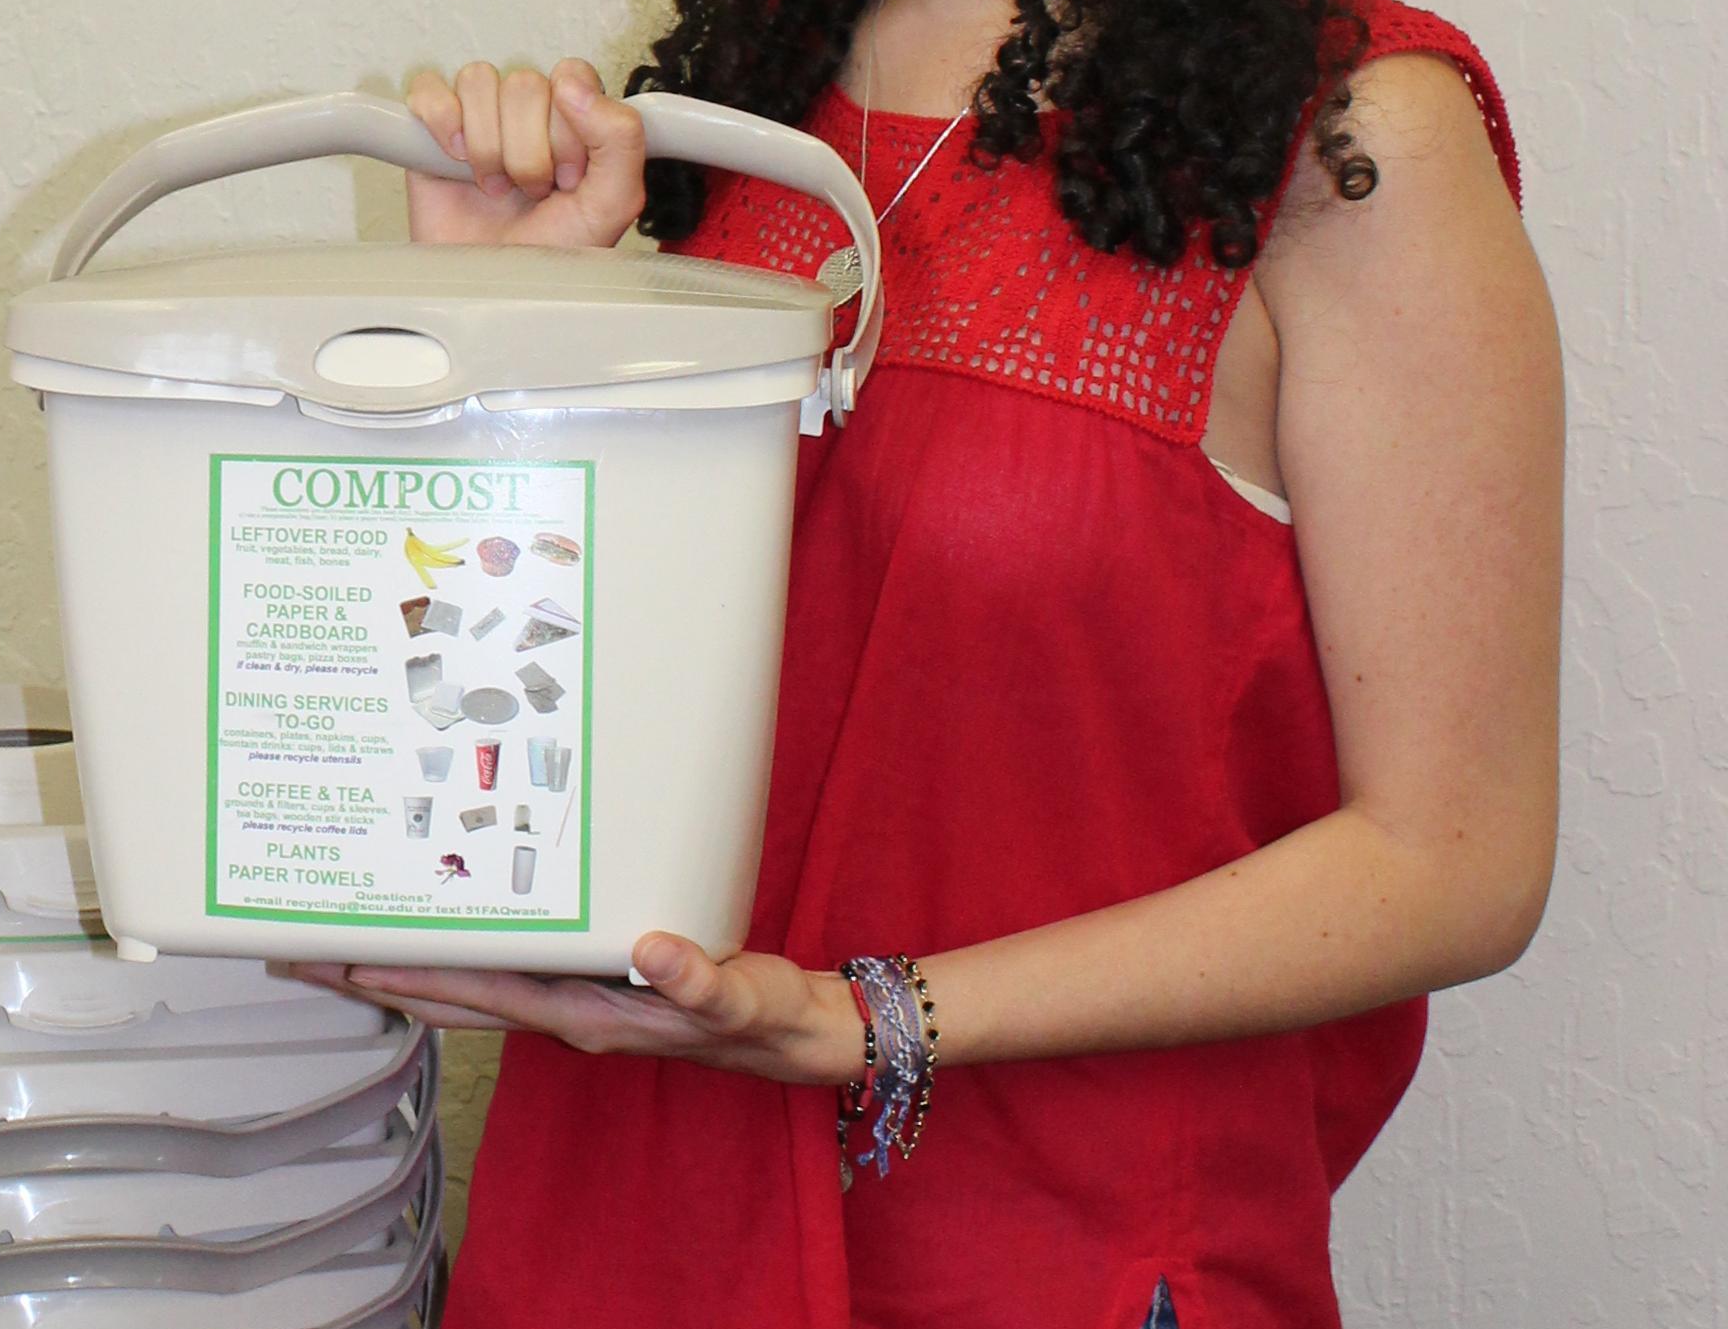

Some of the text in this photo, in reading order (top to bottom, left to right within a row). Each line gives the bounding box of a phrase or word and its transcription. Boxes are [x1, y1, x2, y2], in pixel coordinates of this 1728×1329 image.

[272, 468, 530, 511] COMPOST
[231, 526, 388, 545] LEFTOVER FOOD
[320, 557, 350, 566] bones
[243, 584, 372, 602] FOOD-SOILED
[267, 604, 347, 621] PAPER &
[247, 623, 368, 641] CARDBOARD
[237, 661, 378, 676] if clean & dry, please recycle
[226, 691, 388, 712] DINING SERVICES
[275, 714, 335, 730] TO-GO
[248, 751, 362, 764] please recycle utensils
[238, 782, 374, 803] COFFEE & TEA
[242, 821, 367, 835] please recycle coffee lids
[267, 843, 341, 861] PLANTS
[229, 864, 375, 887] PAPER TOWELS
[244, 896, 282, 905] e-mail
[286, 898, 413, 913] recycling@scu.edu
[436, 905, 461, 914] text
[466, 906, 550, 916] 51FAQwaste
[355, 891, 432, 903] Questions?
